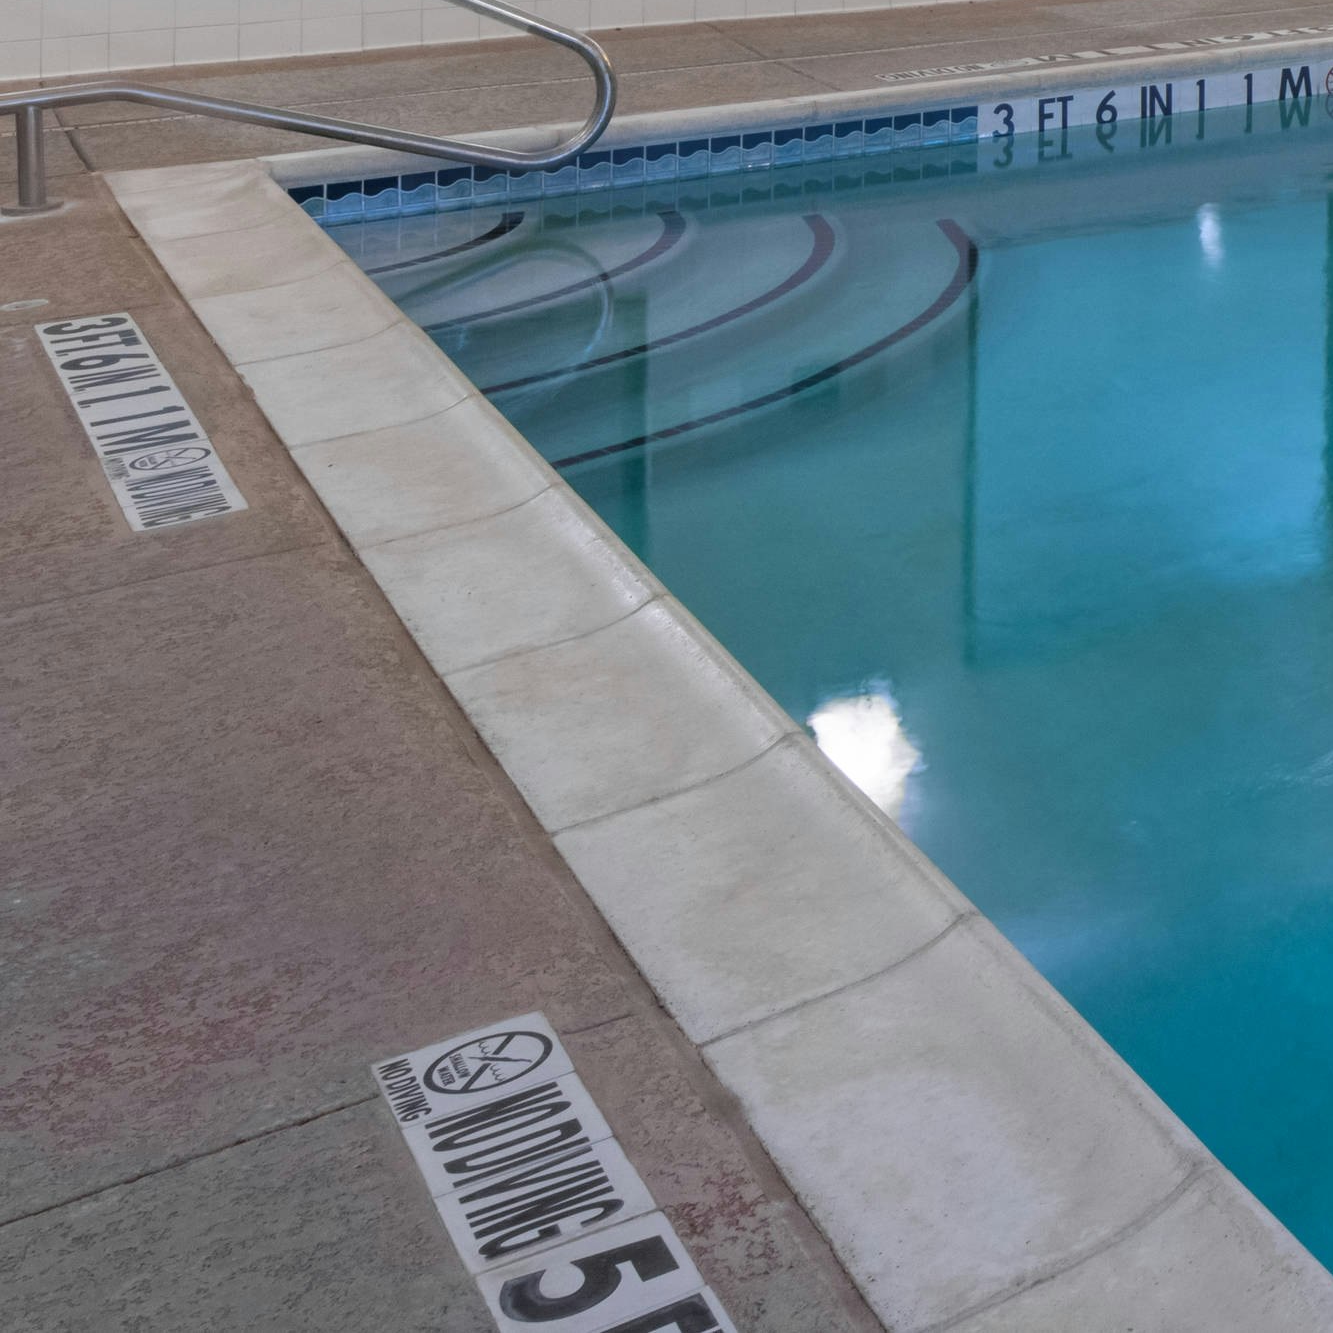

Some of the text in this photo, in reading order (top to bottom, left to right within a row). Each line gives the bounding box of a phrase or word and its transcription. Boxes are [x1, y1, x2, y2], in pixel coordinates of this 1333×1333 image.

[993, 103, 1015, 137] 3
[1039, 95, 1074, 132] FT
[1096, 90, 1118, 124] 6
[1141, 83, 1172, 118] IN
[1244, 73, 1253, 105] 1
[1279, 66, 1312, 100] M
[42, 317, 128, 335] 3
[60, 353, 149, 370] 6
[90, 405, 185, 427] 1
[96, 419, 199, 456] M
[130, 479, 232, 528] DIVING
[378, 1058, 432, 1122] NO DIVING
[425, 1081, 571, 1152] NO
[443, 1117, 624, 1260] DIVING
[499, 1234, 680, 1322] 5
